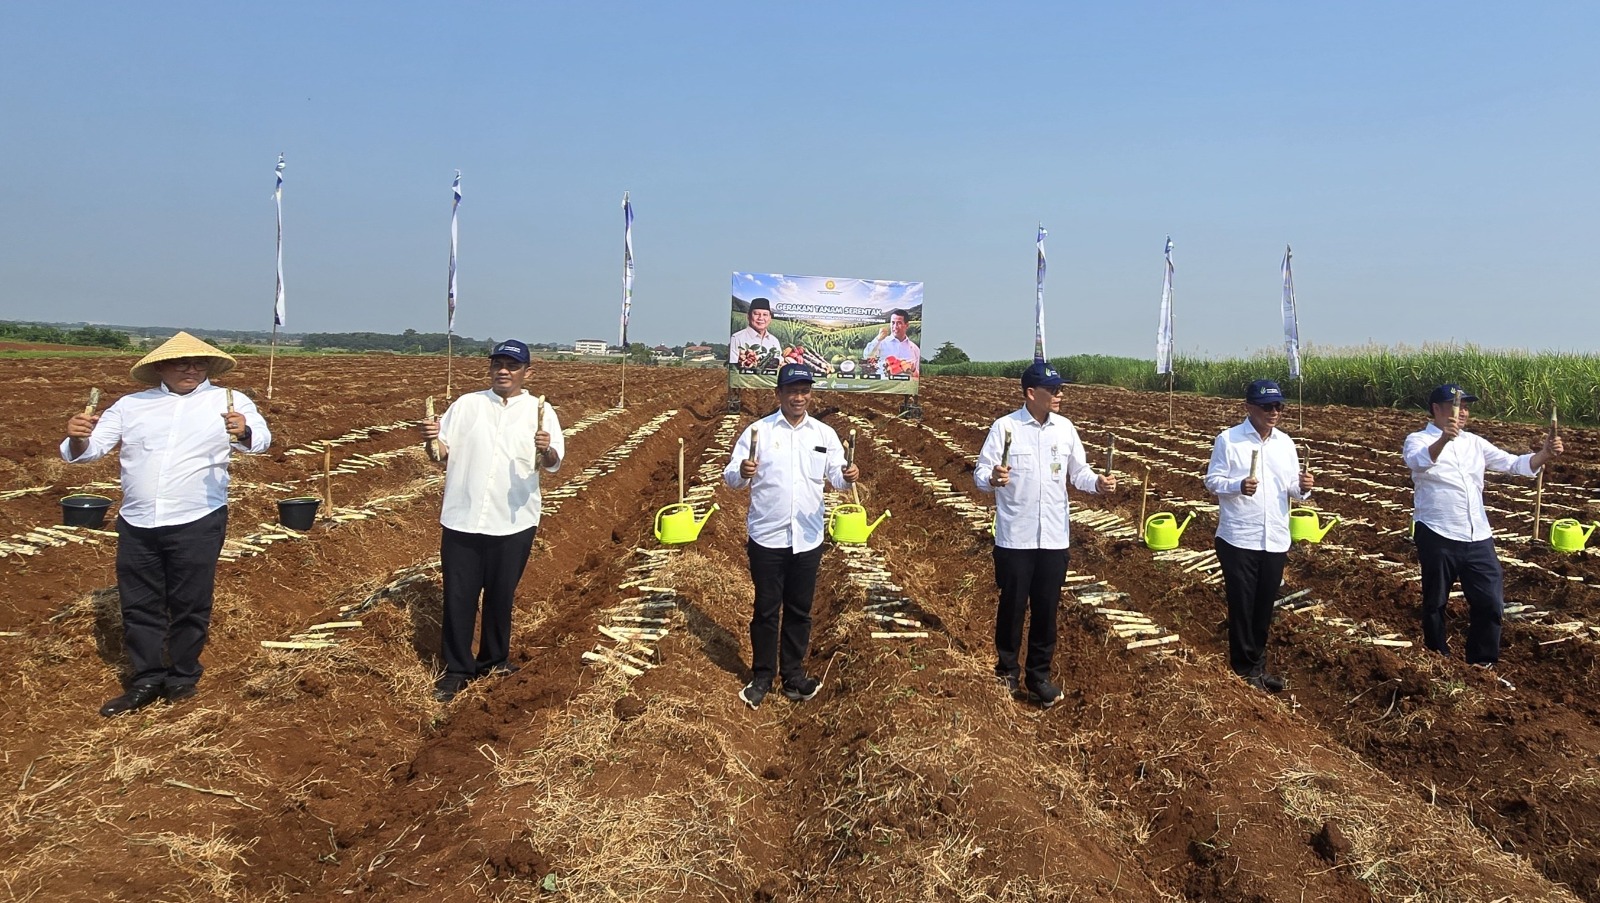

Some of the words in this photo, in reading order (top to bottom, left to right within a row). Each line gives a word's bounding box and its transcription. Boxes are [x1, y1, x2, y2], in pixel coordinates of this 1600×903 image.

[776, 303, 813, 313] GERAKAN
[814, 304, 843, 314] TANAM
[844, 306, 882, 316] SERENTAK
